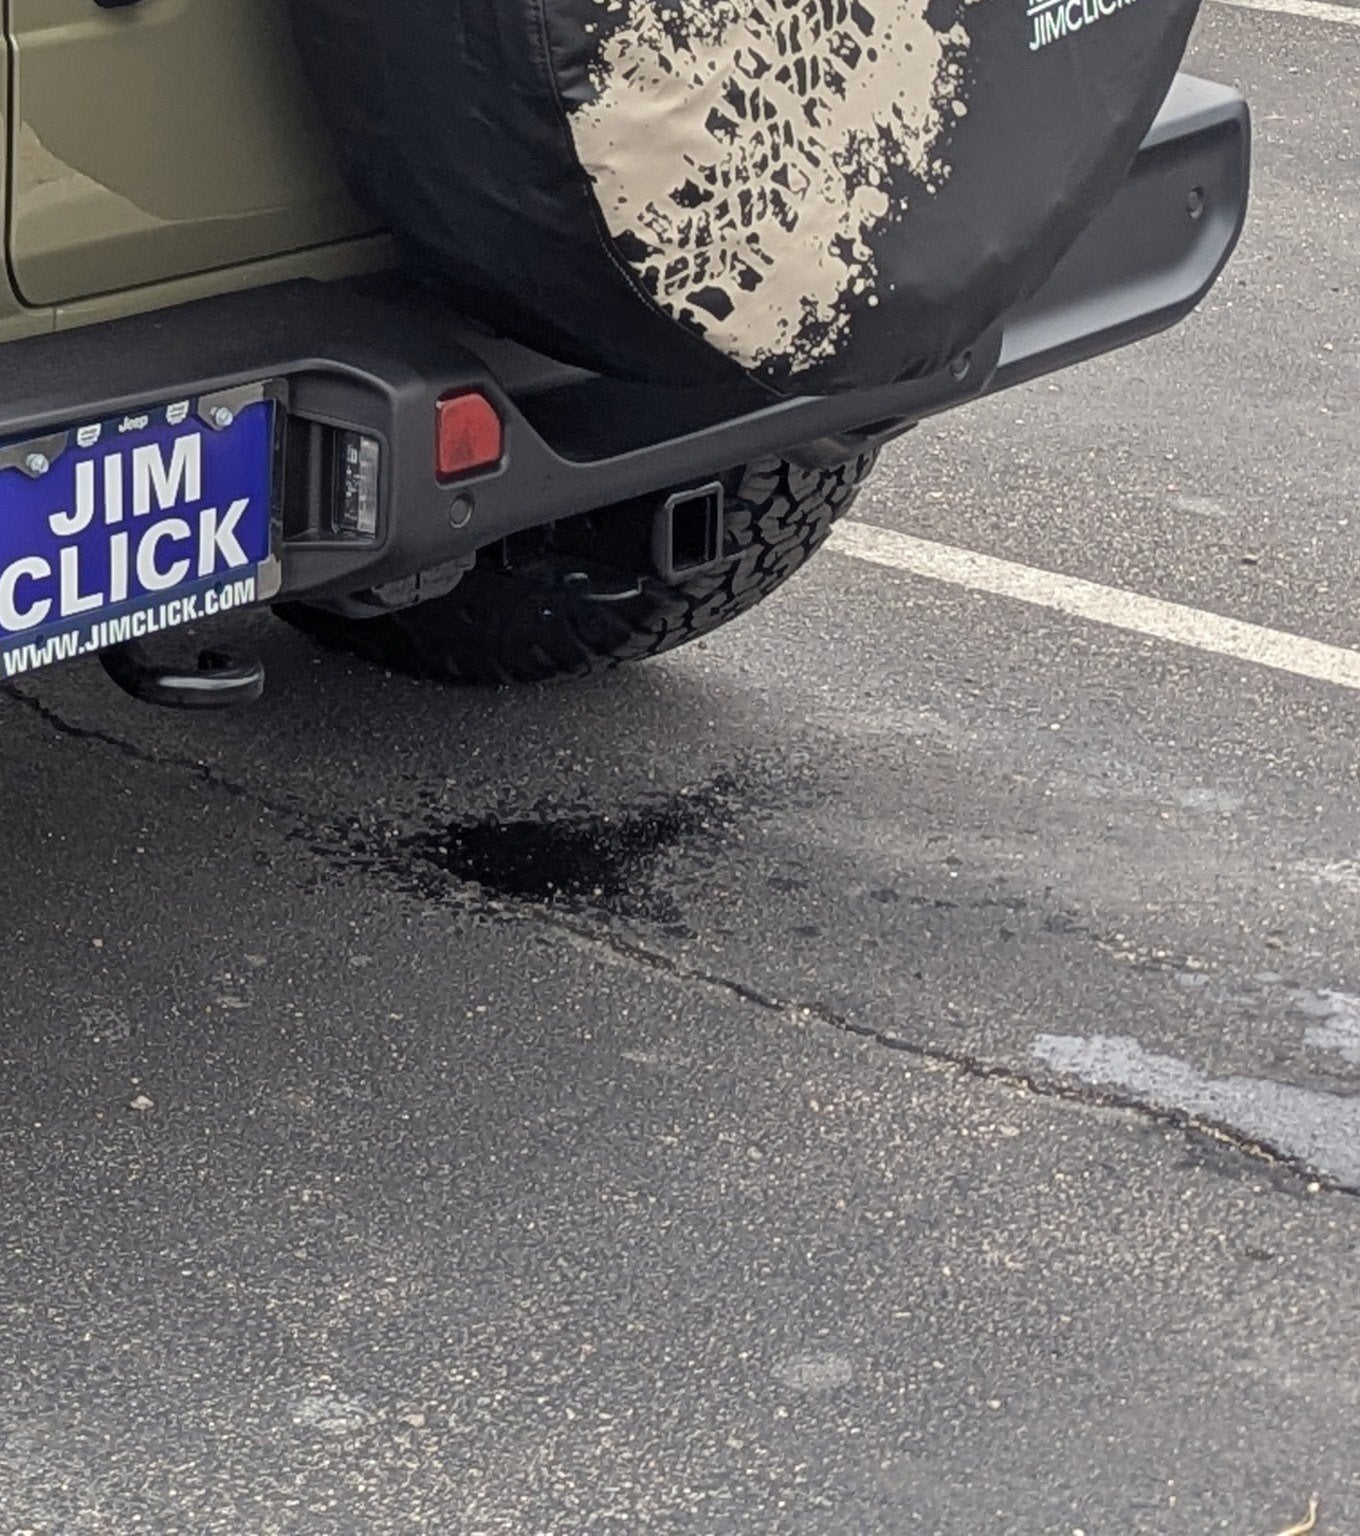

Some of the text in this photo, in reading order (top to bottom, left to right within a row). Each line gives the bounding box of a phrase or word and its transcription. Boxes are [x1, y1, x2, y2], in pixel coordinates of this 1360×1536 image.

[118, 415, 149, 434] Jeep
[48, 432, 202, 537] JIM
[3, 576, 256, 677] WWW.JIMCLICK.COM
